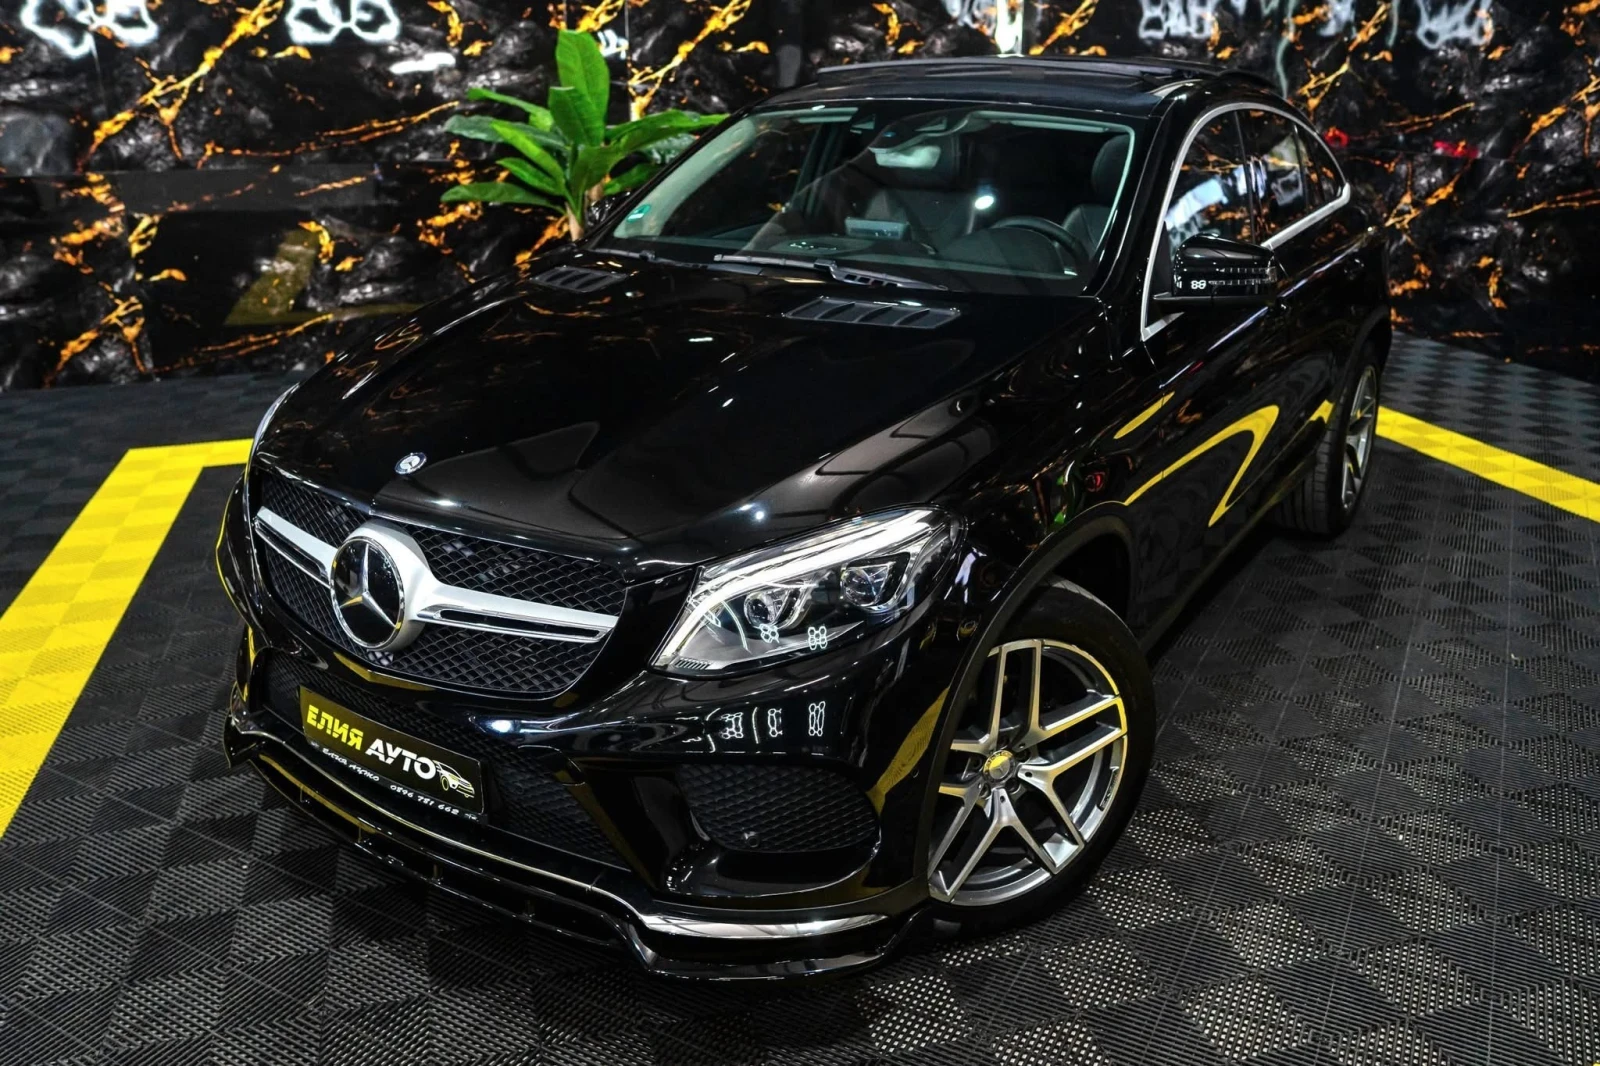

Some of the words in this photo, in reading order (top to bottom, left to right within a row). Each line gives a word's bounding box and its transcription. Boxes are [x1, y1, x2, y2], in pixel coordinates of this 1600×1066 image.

[306, 705, 364, 751] ЕЛИЯ
[365, 738, 436, 780] АУТО
[389, 784, 414, 798] 0896
